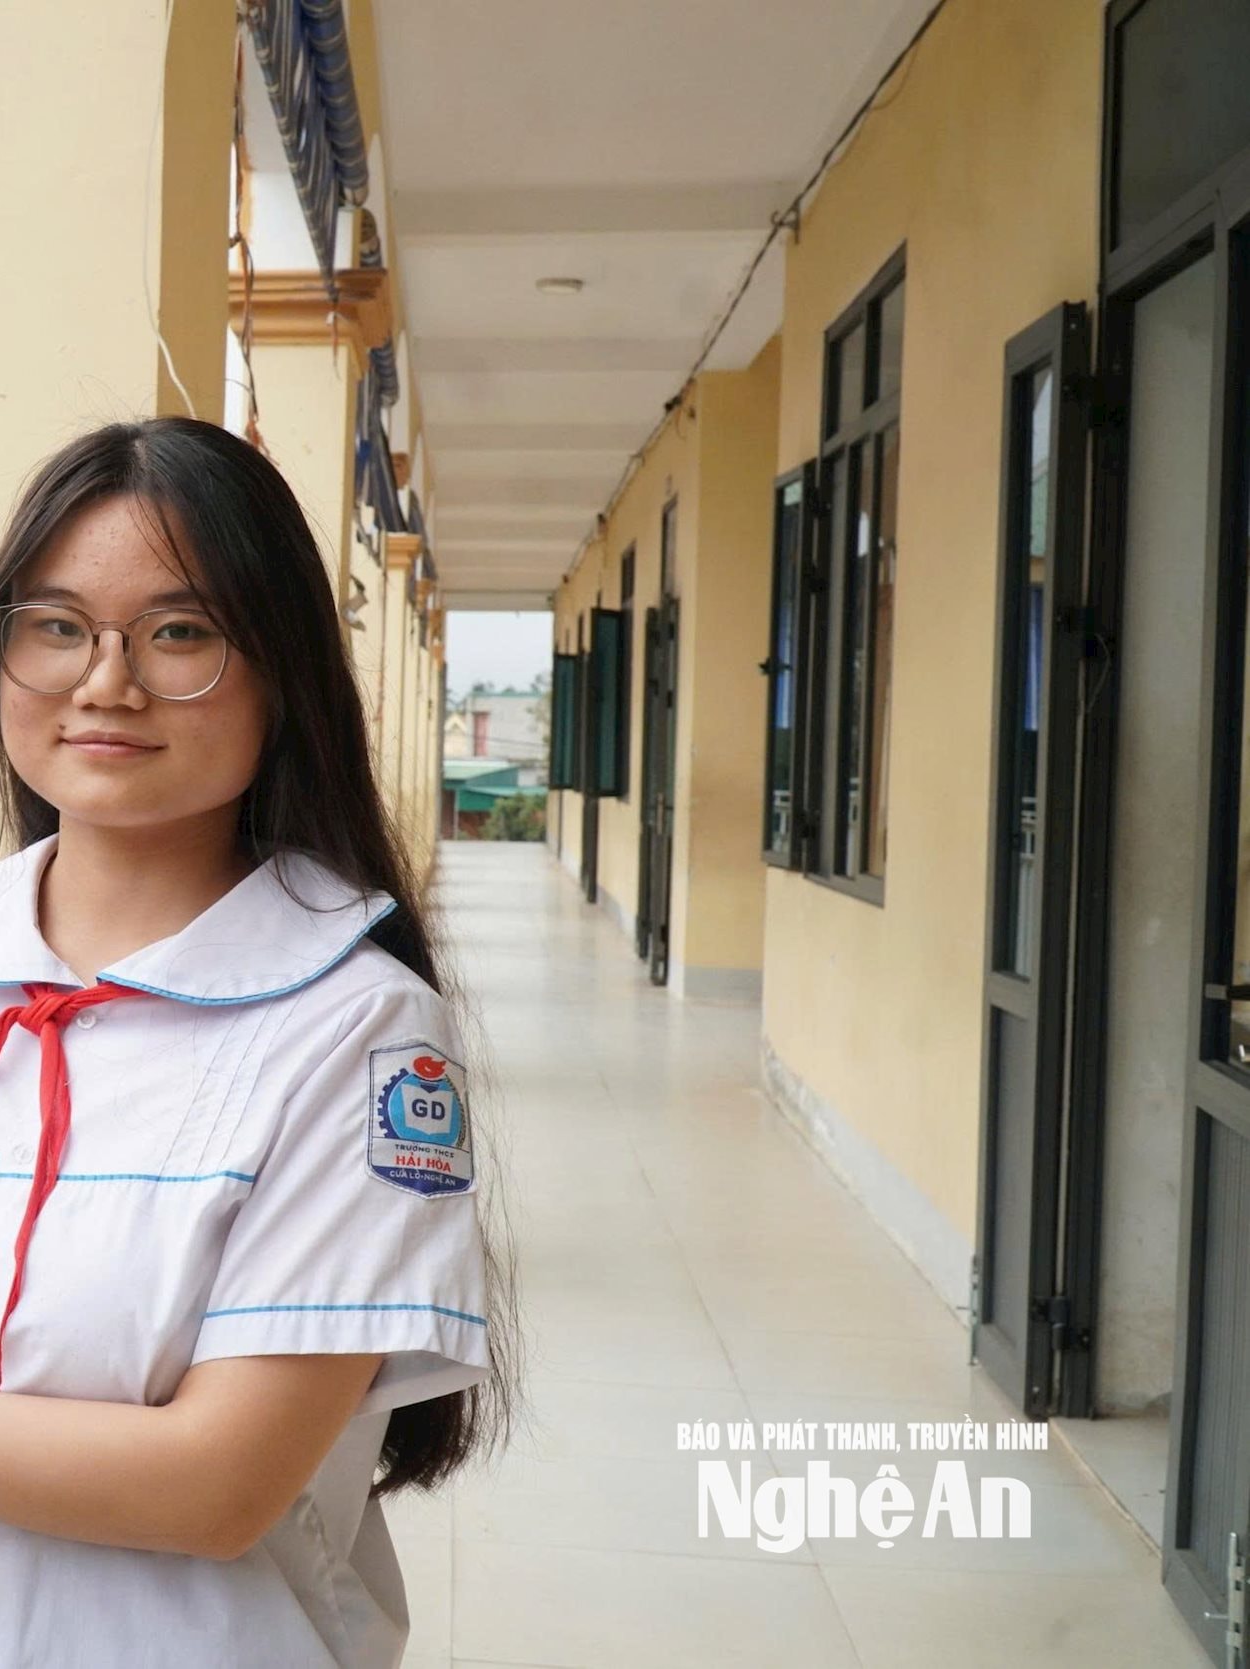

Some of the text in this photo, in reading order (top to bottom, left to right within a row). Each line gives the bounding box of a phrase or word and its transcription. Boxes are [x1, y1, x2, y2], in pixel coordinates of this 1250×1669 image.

[411, 1098, 446, 1121] GD
[395, 1151, 452, 1173] HẢI HÒA
[434, 1148, 455, 1159] THCS
